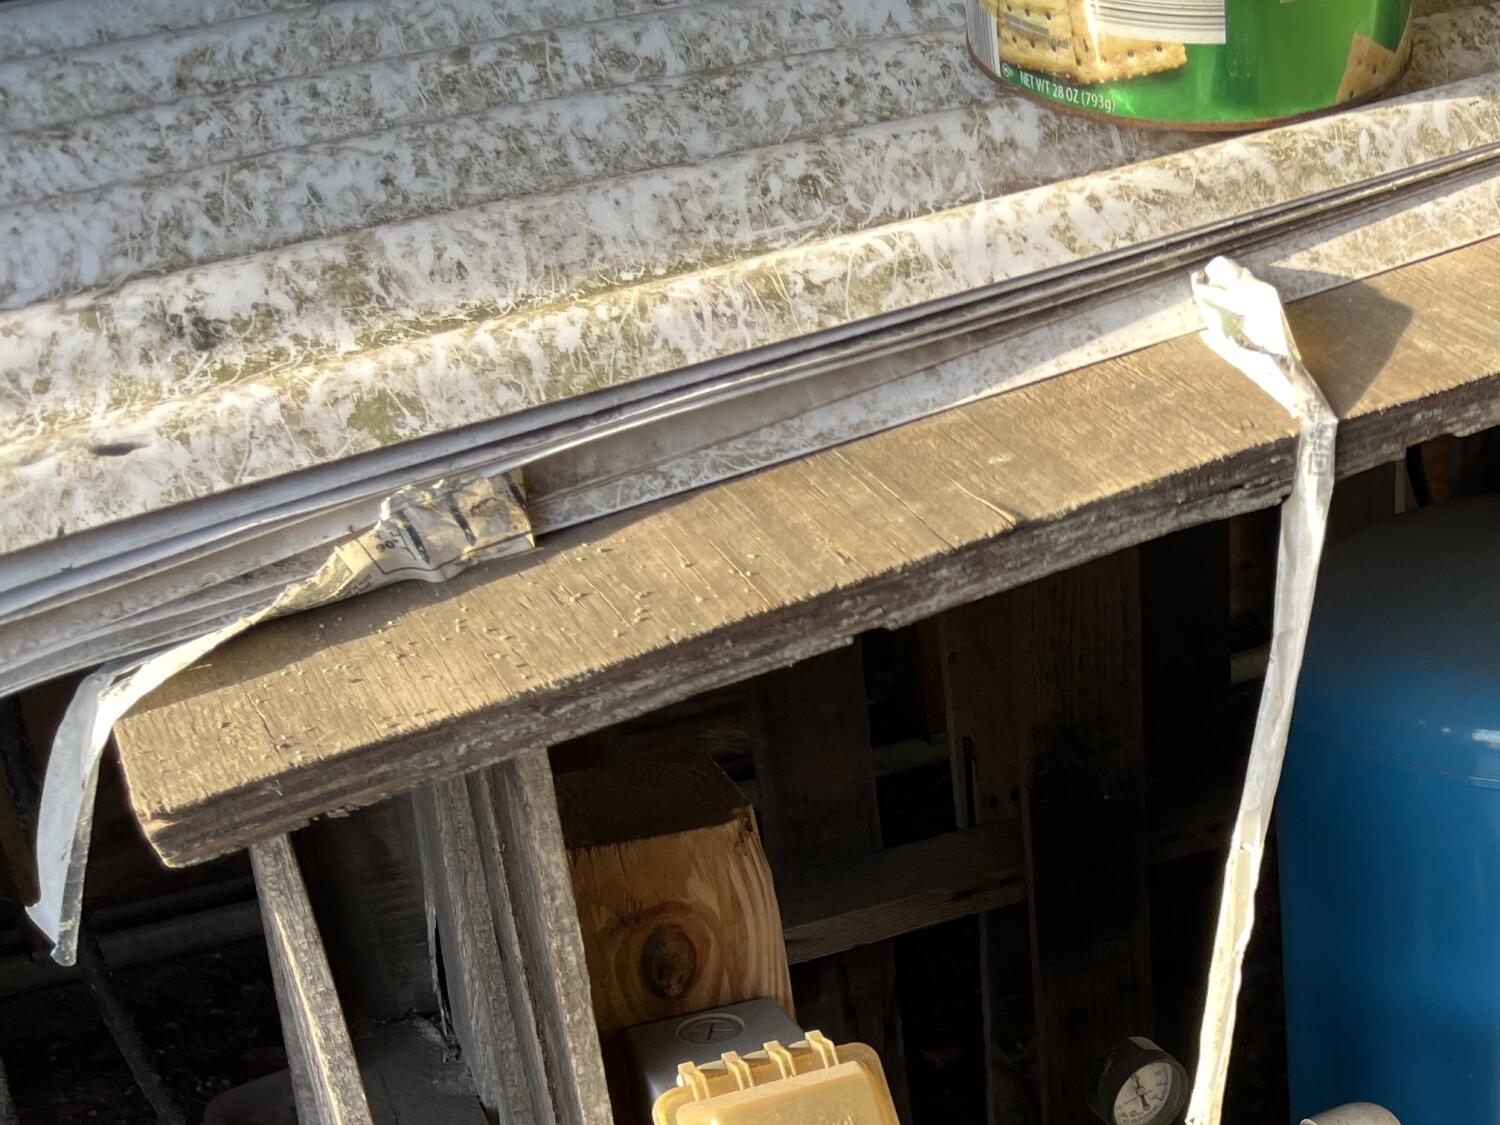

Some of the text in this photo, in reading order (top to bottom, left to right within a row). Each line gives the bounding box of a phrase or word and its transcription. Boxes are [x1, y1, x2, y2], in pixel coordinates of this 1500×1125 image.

[1020, 70, 1116, 113] NET WT 28 OZ (793g)
